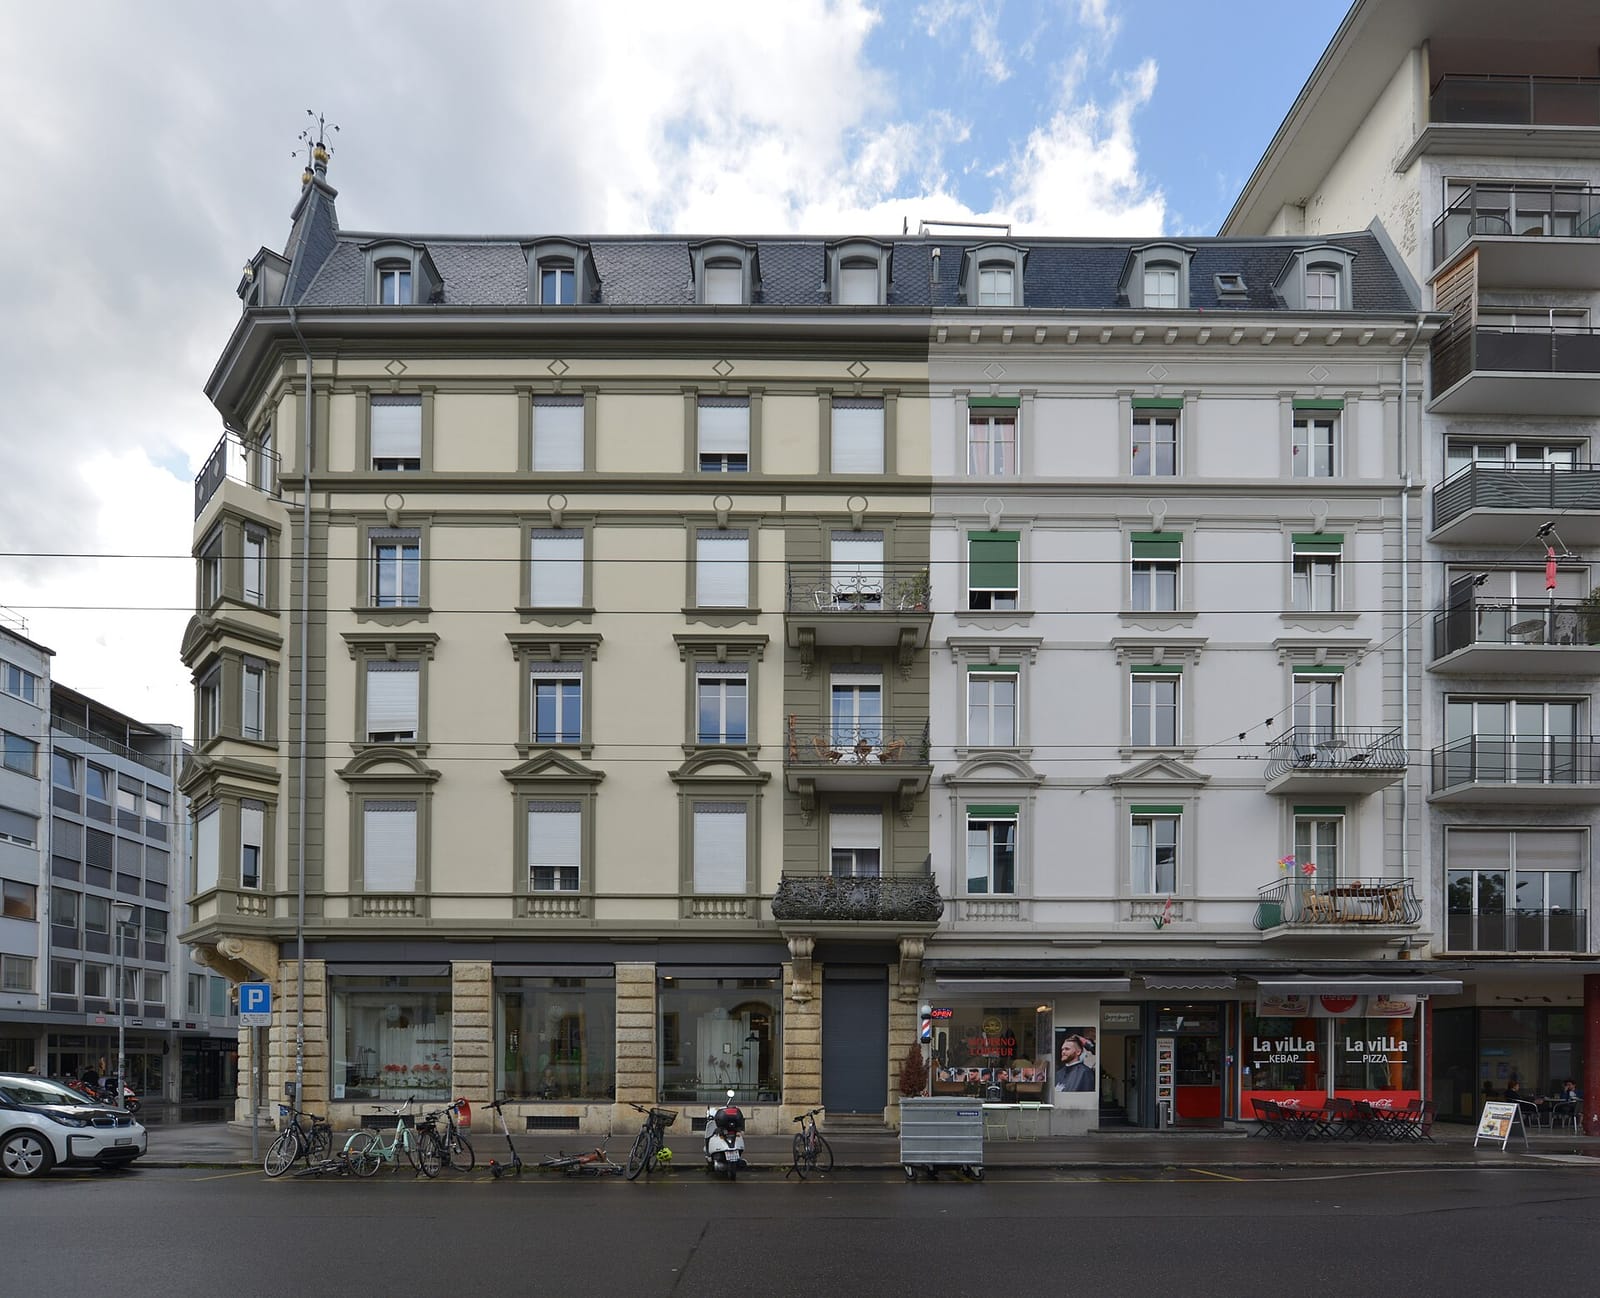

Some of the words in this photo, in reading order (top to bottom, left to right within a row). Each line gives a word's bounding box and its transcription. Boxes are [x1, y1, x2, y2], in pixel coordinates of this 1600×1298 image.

[249, 989, 263, 1010] P
[1253, 1036, 1271, 1052] La
[1275, 1036, 1315, 1052] viLLa
[1345, 1036, 1364, 1052] La
[1367, 1036, 1408, 1052] viLLa
[1269, 1054, 1299, 1063] KEBAP
[1362, 1054, 1388, 1063] PIZZA
